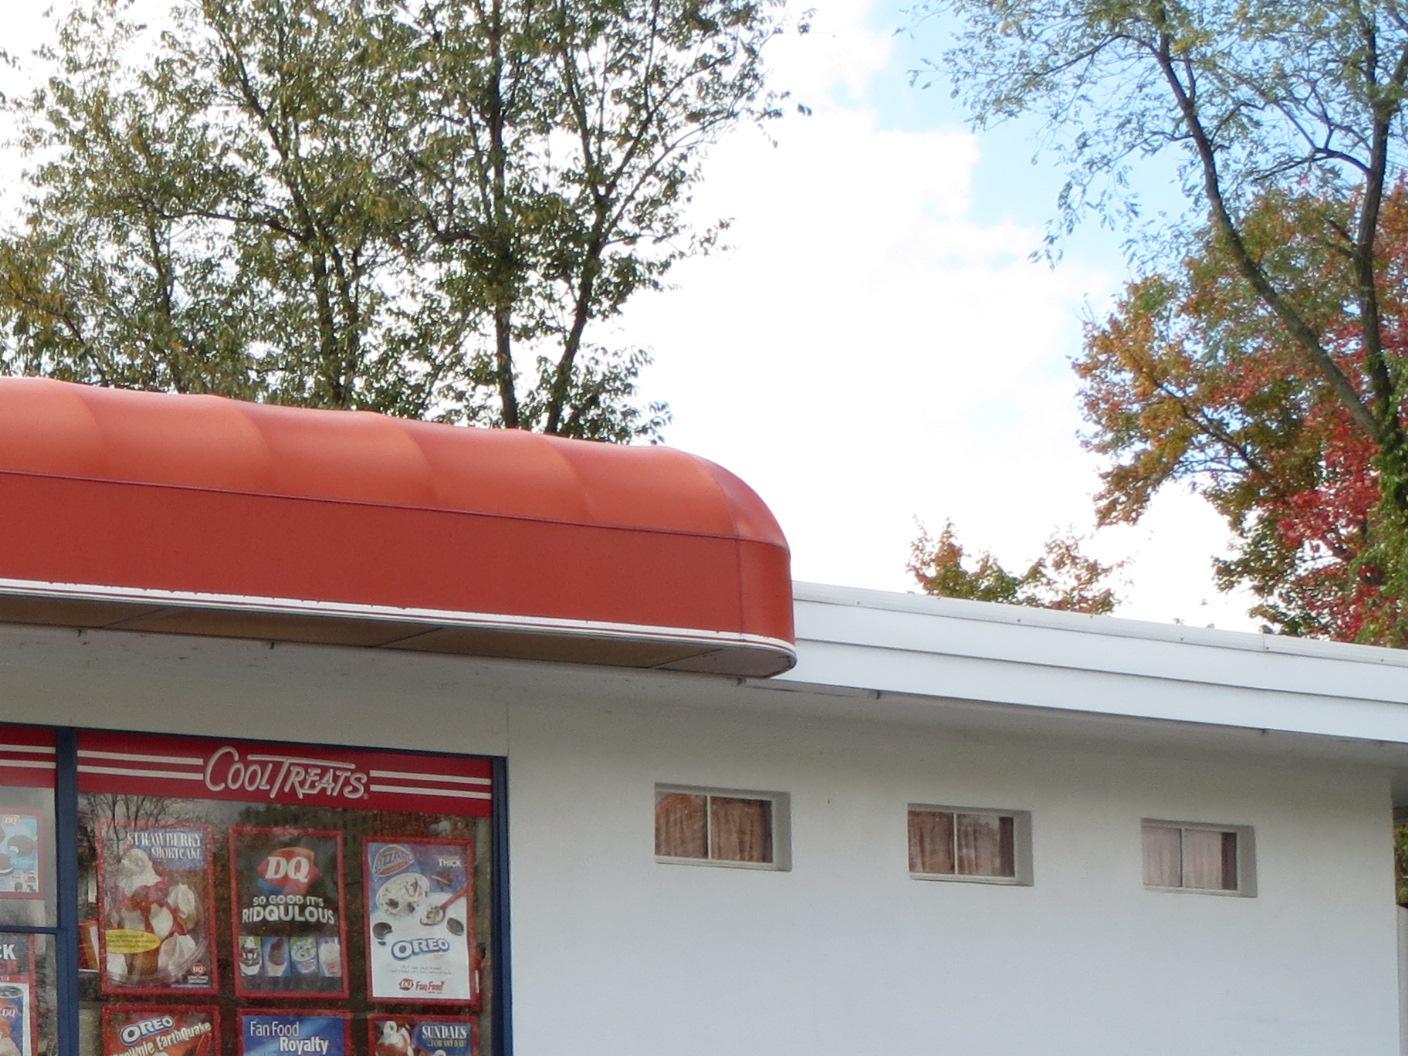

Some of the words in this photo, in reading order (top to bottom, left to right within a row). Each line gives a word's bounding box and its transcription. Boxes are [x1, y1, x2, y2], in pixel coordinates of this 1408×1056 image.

[126, 831, 201, 848] STRAWBERRY
[151, 847, 202, 860] SHORTCAKE
[264, 856, 310, 883] DQ
[253, 896, 266, 906] SO
[269, 894, 304, 905] GOOD
[306, 896, 324, 907] IT'S
[242, 905, 335, 925] RIDQULOUS
[392, 938, 450, 961] OREO
[0, 1008, 17, 1018] DQ
[122, 1015, 175, 1045] OREO
[250, 1021, 270, 1037] Fan
[272, 1021, 300, 1037] Food
[422, 1025, 468, 1039] SUNDAES
[279, 1036, 330, 1055] Royalty
